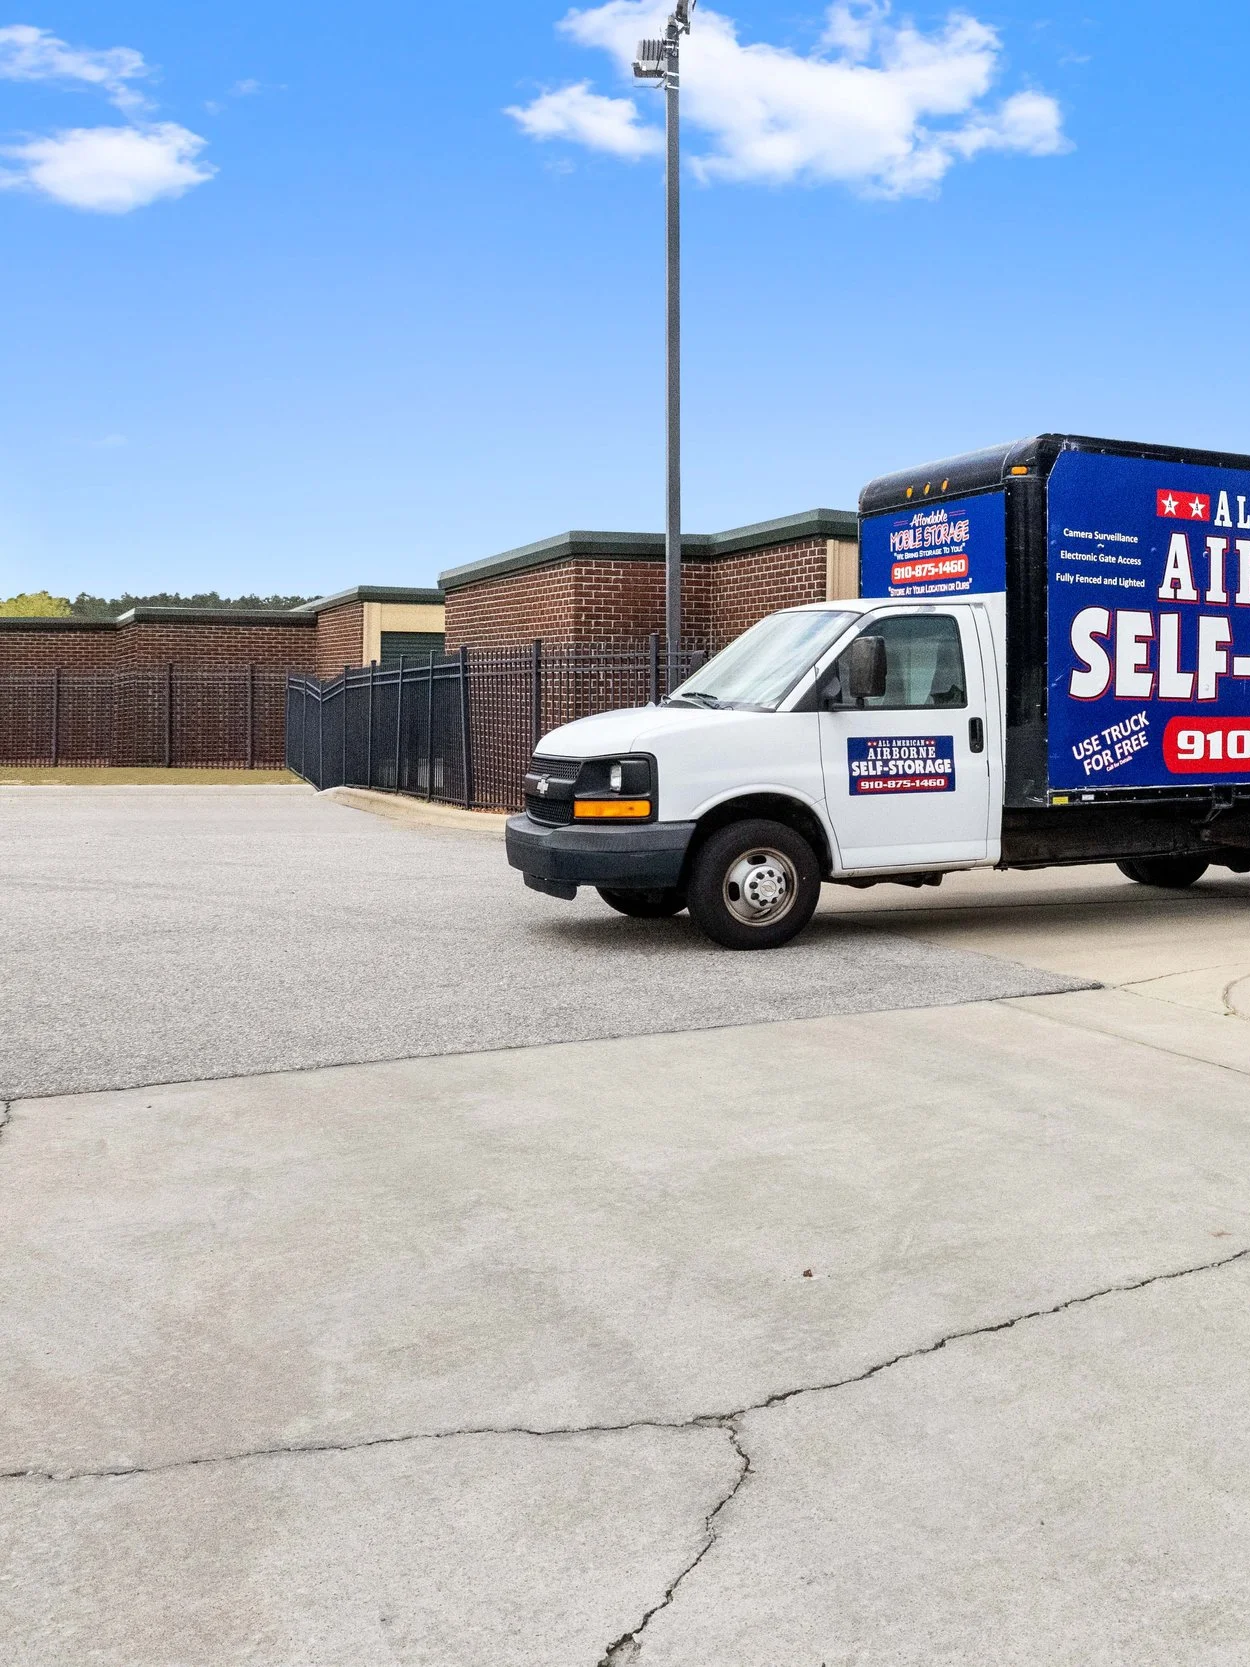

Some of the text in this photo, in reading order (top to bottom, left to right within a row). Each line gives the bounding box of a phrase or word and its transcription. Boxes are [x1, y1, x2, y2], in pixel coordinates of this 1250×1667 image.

[909, 509, 948, 527] Affordable
[889, 520, 969, 552] MOBILE STORAGE
[1063, 528, 1138, 543] Camera Surveillance
[1060, 550, 1142, 565] Electronic Gate Access
[893, 559, 966, 580] 910-875-1460
[1056, 572, 1145, 588] Fully Fenced and Lighted
[892, 739, 925, 747] AMERICAN
[1072, 710, 1150, 760] USE TRUCK
[867, 746, 936, 760] AIRBORNE
[1083, 731, 1149, 776] FOR FREE
[851, 758, 953, 777] SELF-STORAGE
[860, 778, 945, 790] 910-875-1460
